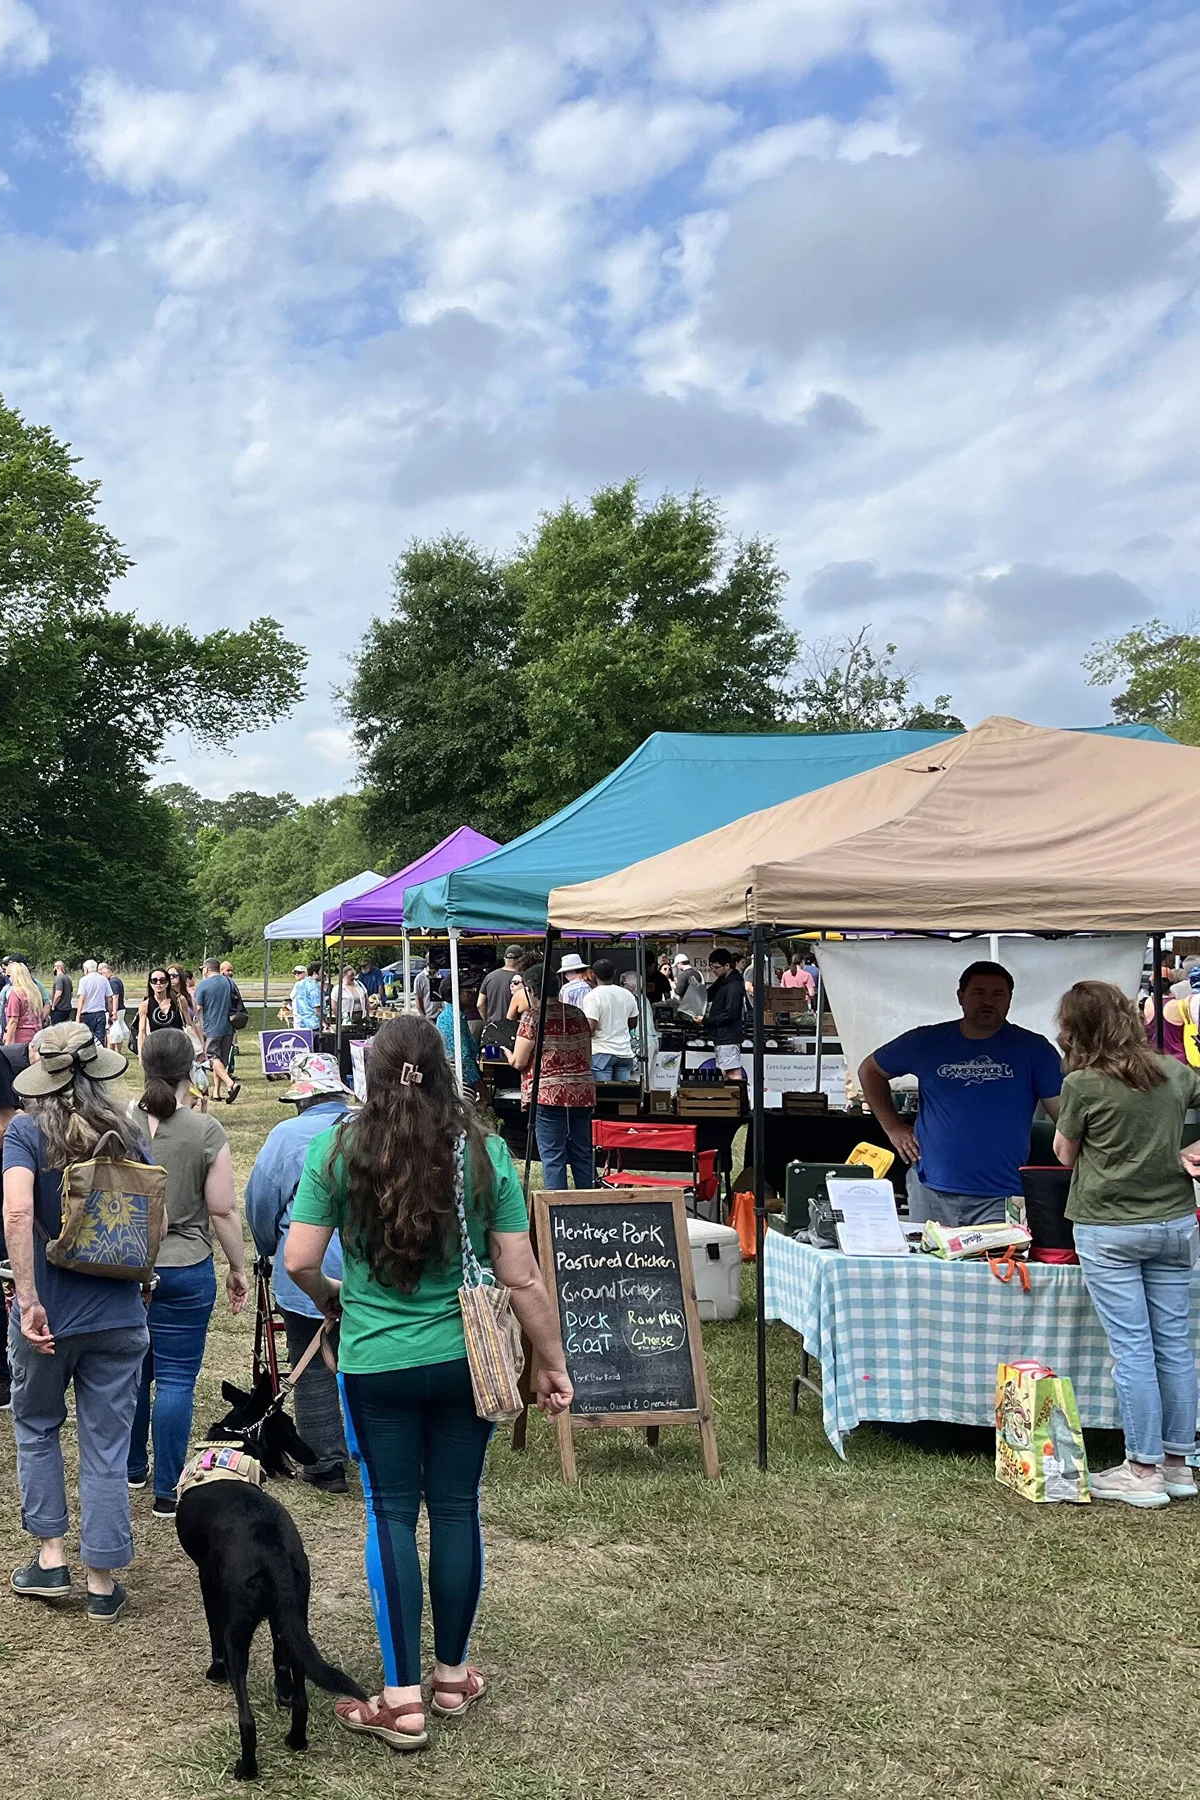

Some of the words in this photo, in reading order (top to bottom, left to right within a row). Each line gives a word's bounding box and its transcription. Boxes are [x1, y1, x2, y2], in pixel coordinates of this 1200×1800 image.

[265, 1051, 291, 1063] LUCKY
[554, 1216, 620, 1244] Heritage
[621, 1220, 665, 1248] Pork
[625, 1252, 676, 1269] Chicken
[561, 1281, 616, 1302] Ground
[617, 1278, 661, 1304] Turkey
[627, 1310, 656, 1326] Raw
[658, 1309, 683, 1329] Milk
[631, 1328, 675, 1347] Cheese
